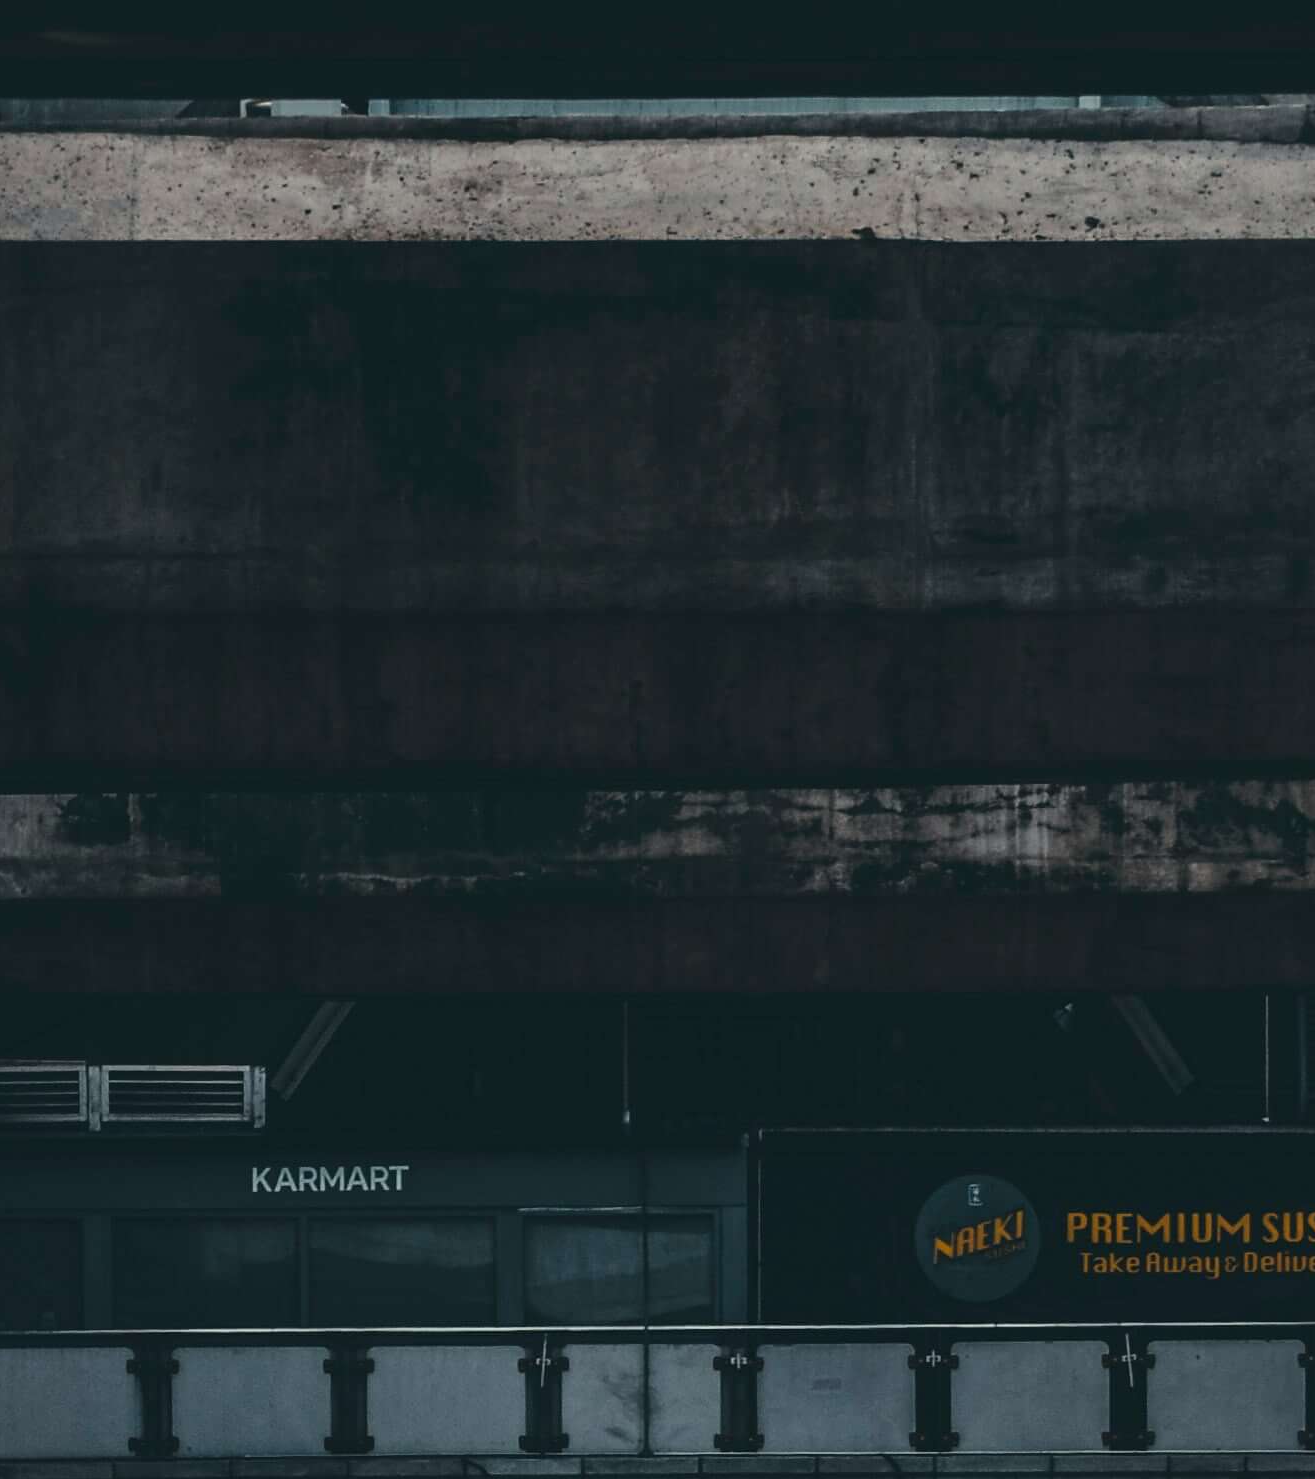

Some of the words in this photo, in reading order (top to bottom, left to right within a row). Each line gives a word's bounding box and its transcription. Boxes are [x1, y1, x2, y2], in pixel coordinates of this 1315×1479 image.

[251, 1164, 411, 1193] KARMART
[932, 1208, 1027, 1265] NAEKI
[1065, 1210, 1253, 1245] PREMIUM
[1079, 1251, 1141, 1273] Take
[1145, 1251, 1221, 1280] Away
